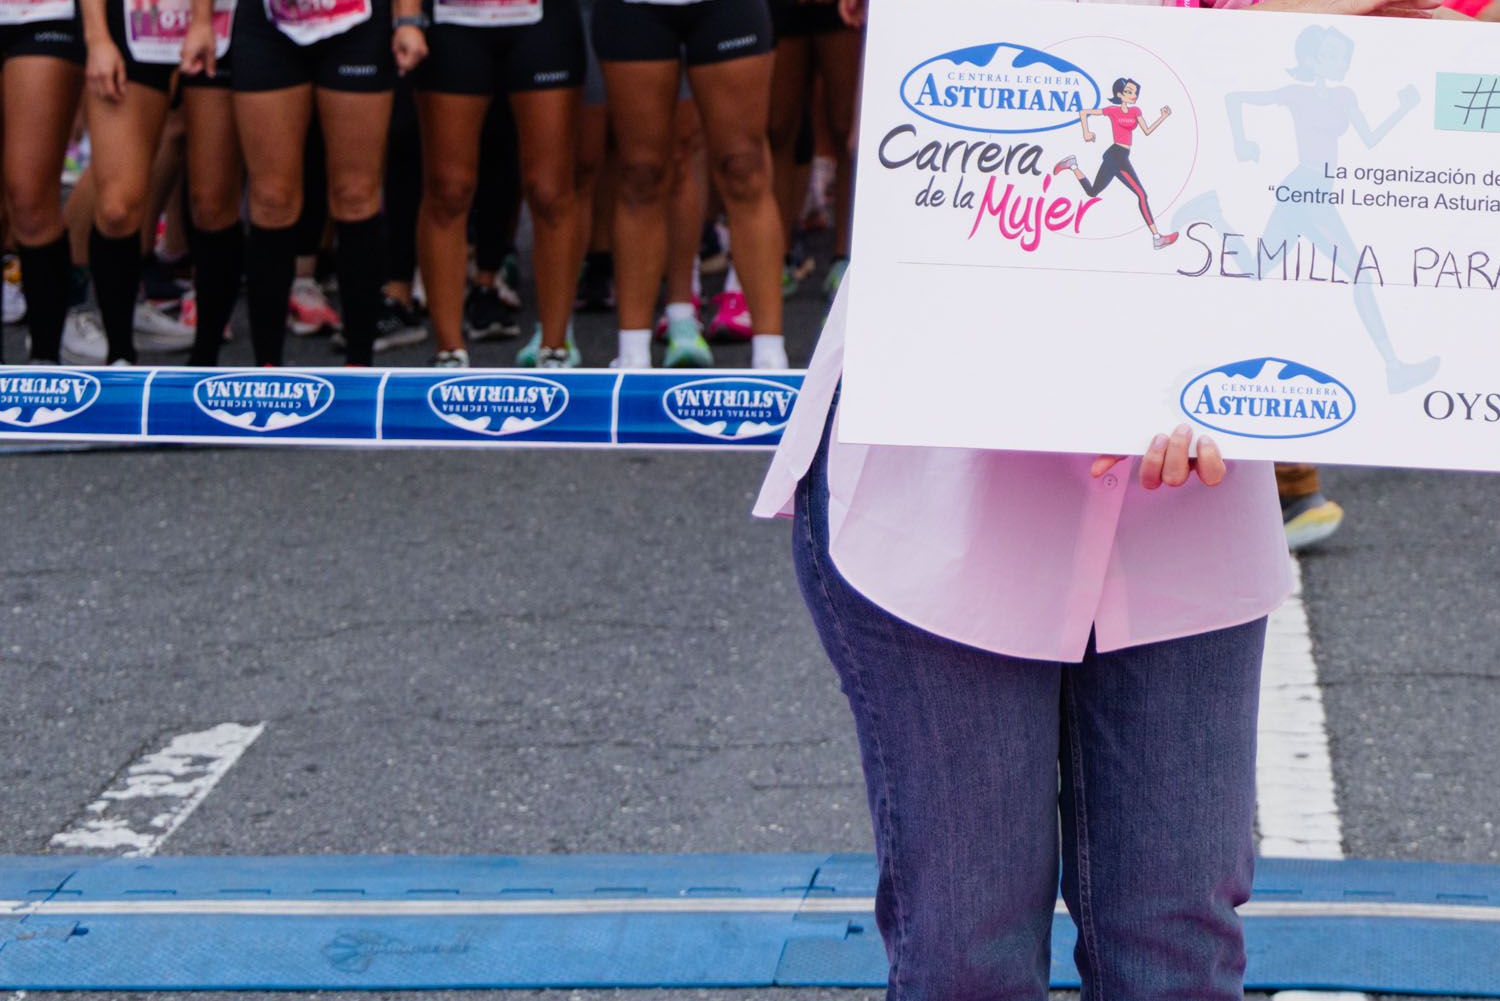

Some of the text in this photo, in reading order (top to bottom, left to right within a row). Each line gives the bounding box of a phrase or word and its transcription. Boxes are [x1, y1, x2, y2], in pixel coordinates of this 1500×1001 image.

[947, 71, 1081, 86] CENTRAL LECHERA
[914, 72, 1084, 113] ASTURIANA
[878, 123, 1044, 177] Carrera
[1324, 162, 1347, 179] La
[1354, 165, 1476, 186] organización
[1351, 188, 1429, 209] Lechera
[915, 173, 1103, 252] de la Mujer
[205, 380, 325, 407] ASTURIANA
[439, 385, 559, 412] ASTURIANA
[674, 389, 795, 417] ASTURIANA
[1193, 384, 1343, 420] ASTURIANA
[1221, 383, 1338, 397] CENTRAL LECHERA
